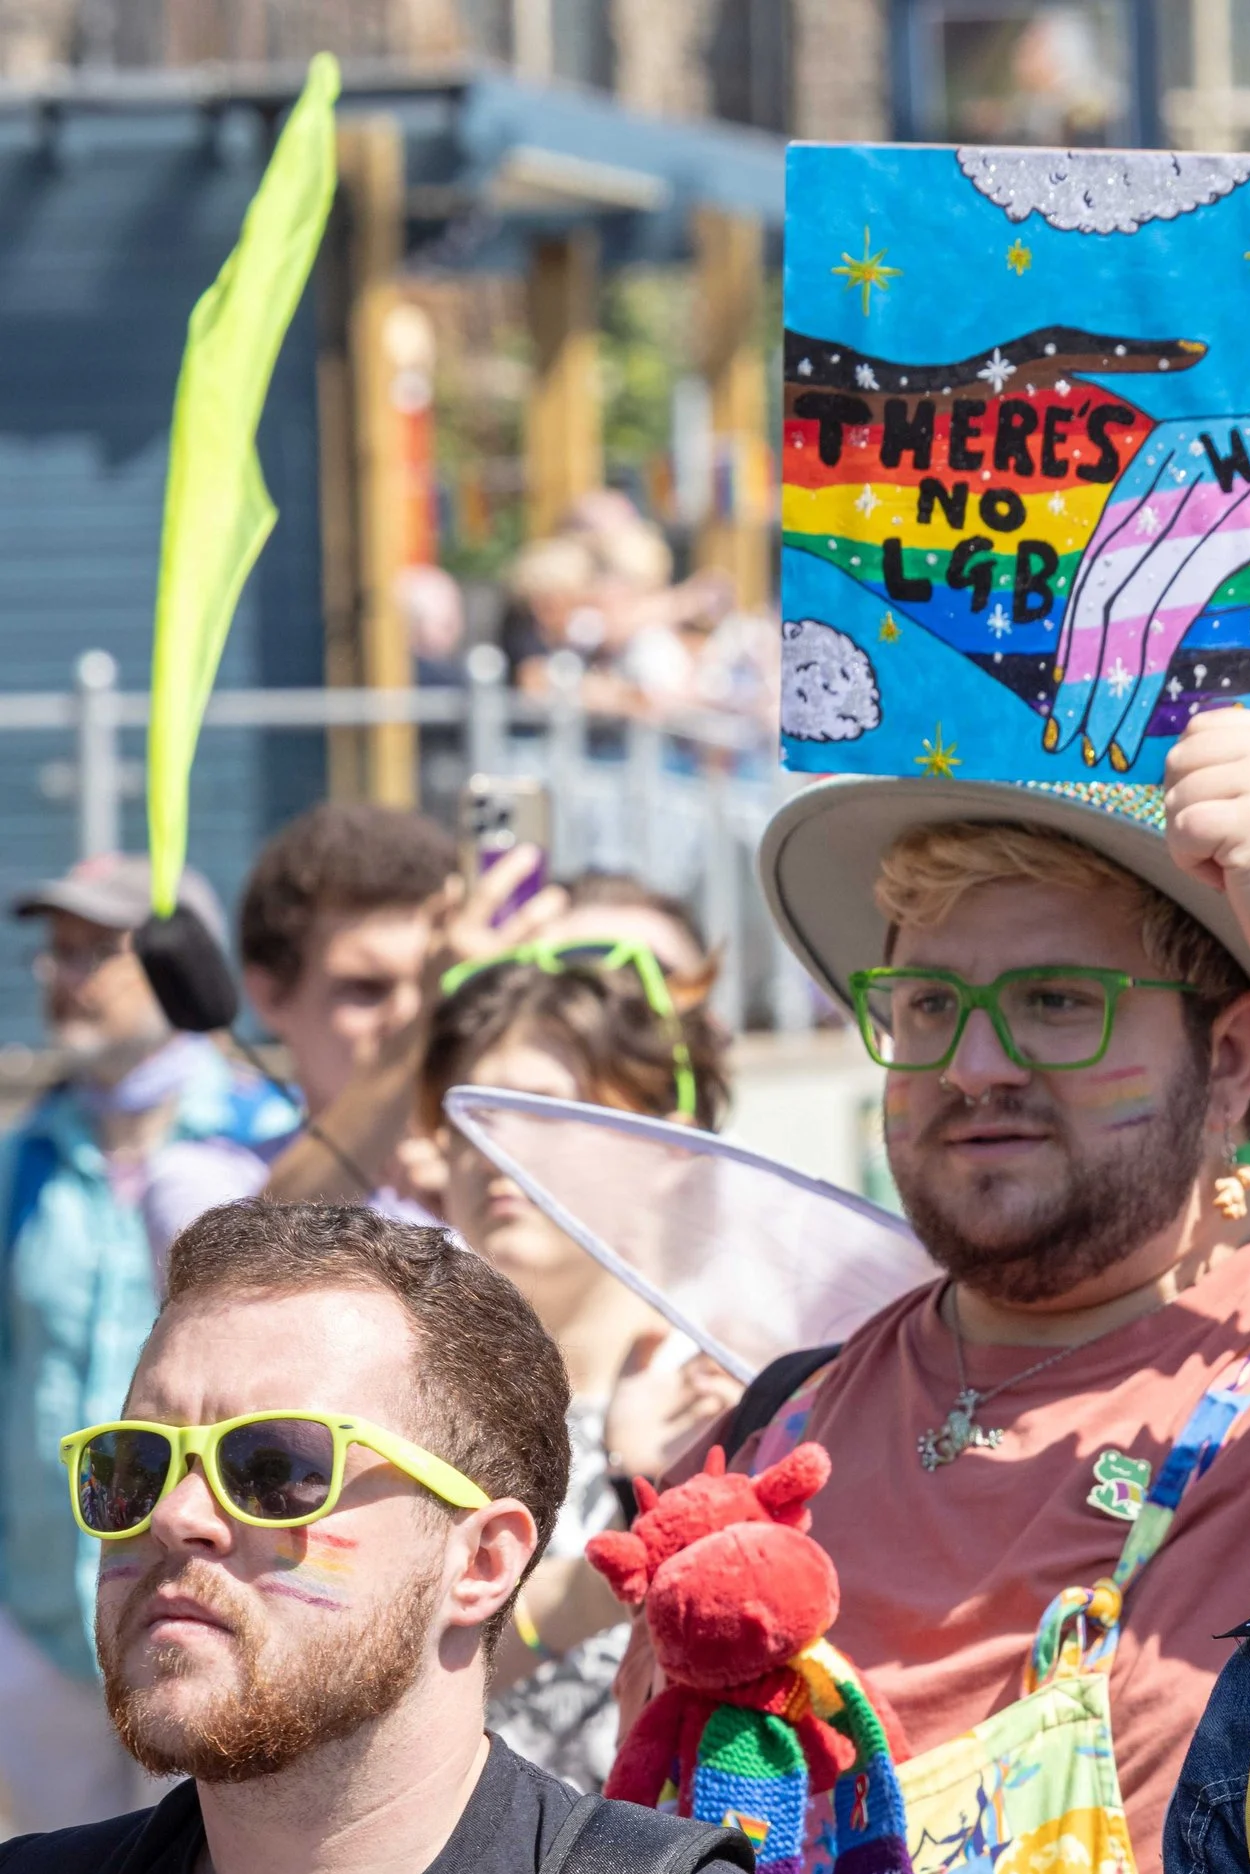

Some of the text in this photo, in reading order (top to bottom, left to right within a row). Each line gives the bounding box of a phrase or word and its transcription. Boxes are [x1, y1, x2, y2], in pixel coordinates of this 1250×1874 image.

[793, 397, 1135, 483] THERE'S
[918, 479, 1026, 532] NO
[883, 538, 1059, 624] LGB
